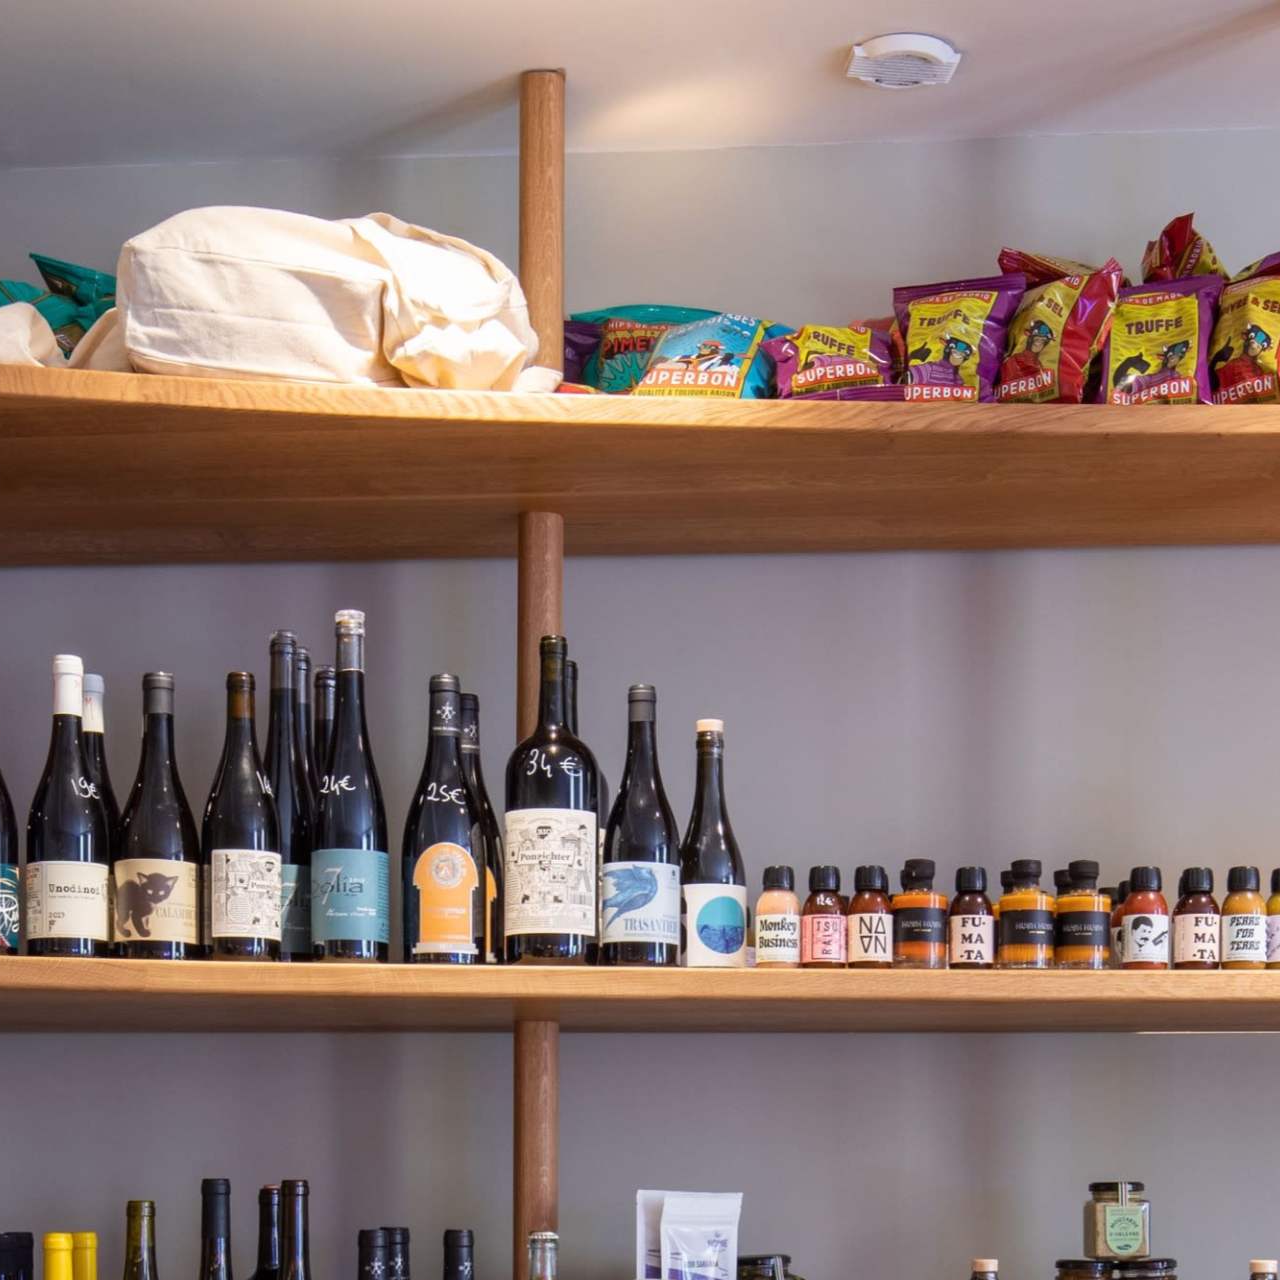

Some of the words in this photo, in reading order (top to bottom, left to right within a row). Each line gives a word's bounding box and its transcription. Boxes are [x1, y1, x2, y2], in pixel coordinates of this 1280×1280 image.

[1125, 316, 1184, 335] TRUFFE
[904, 386, 973, 400] UPERBON
[994, 371, 1052, 399] UPERBON
[1112, 379, 1191, 405] SUPERBON
[71, 776, 101, 799] 19€
[320, 774, 357, 796] 24€
[427, 782, 467, 805] 25€
[759, 918, 798, 933] Monkey
[759, 936, 799, 949] Business
[960, 933, 985, 945] MA
[1193, 933, 1217, 944] MA
